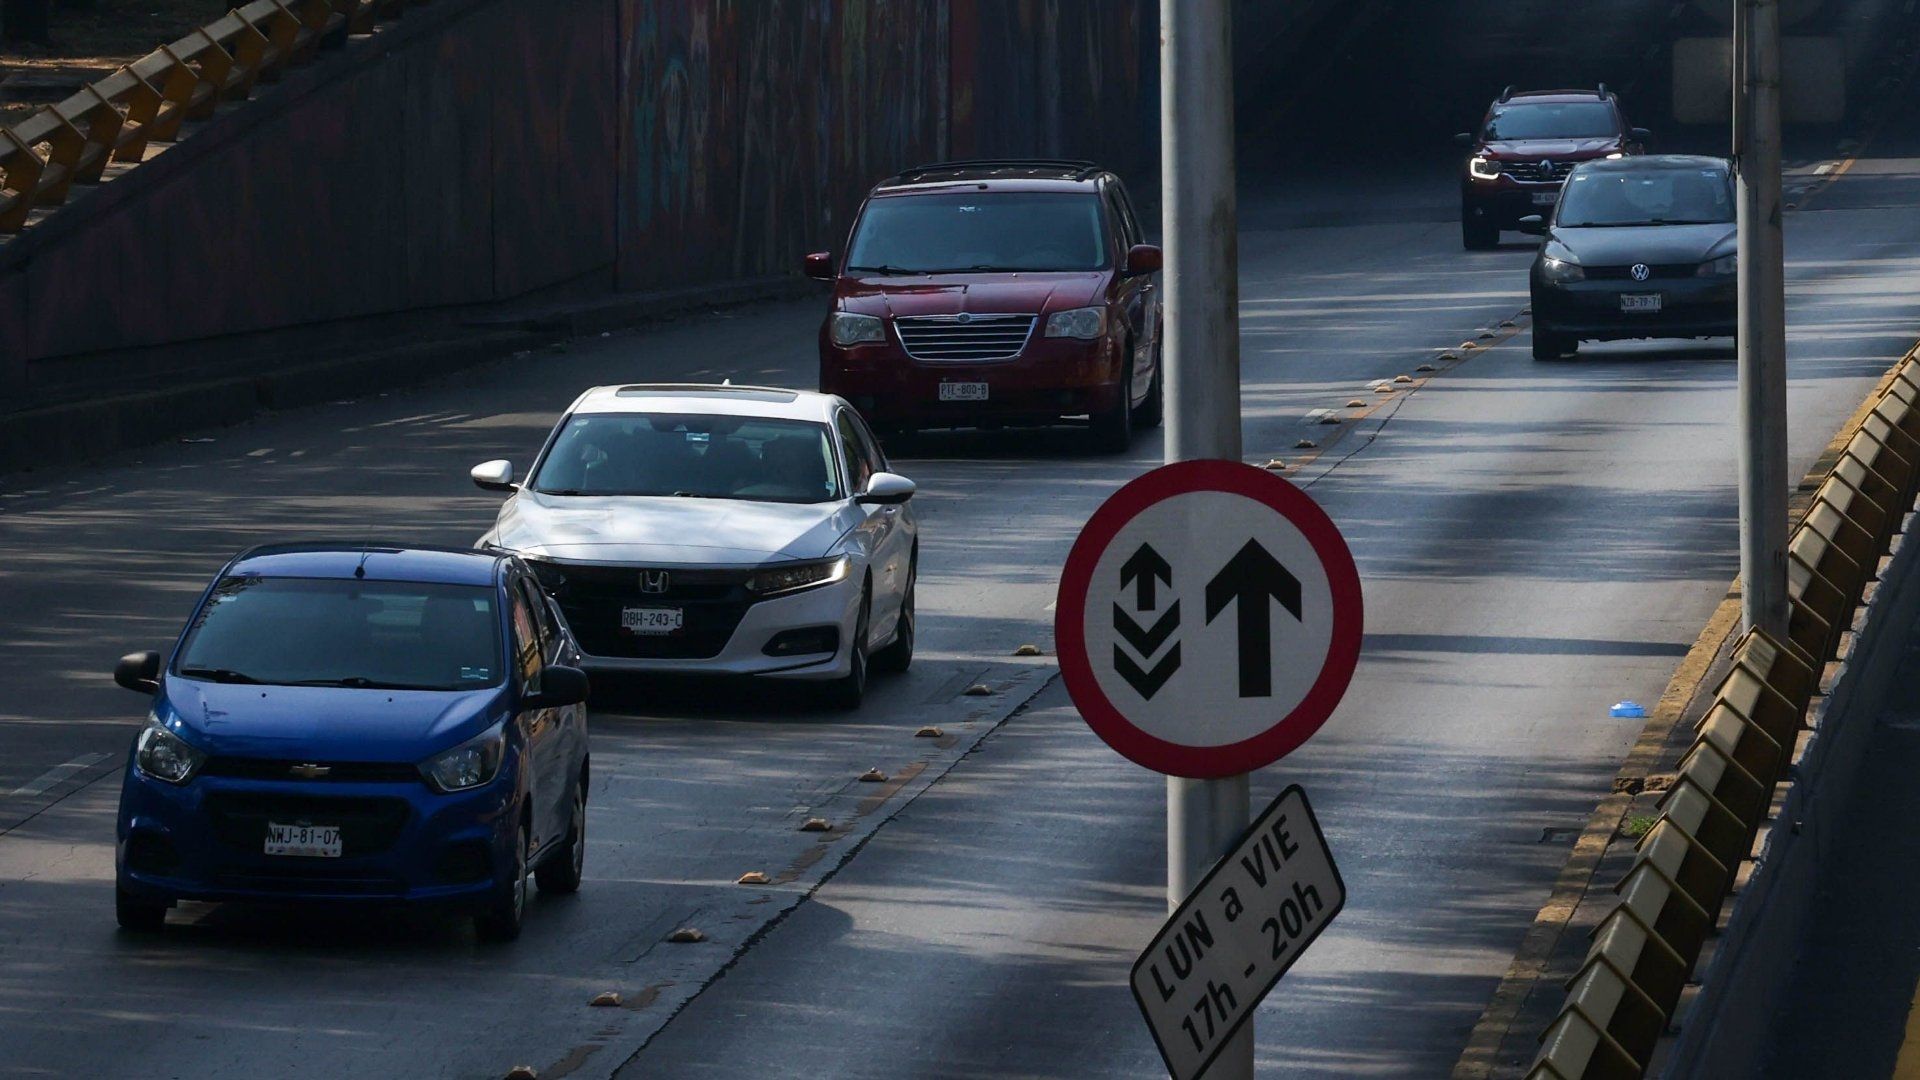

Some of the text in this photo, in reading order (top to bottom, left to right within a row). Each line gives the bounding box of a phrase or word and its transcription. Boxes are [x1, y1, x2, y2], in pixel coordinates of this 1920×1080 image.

[1631, 263, 1650, 281] VW
[623, 611, 682, 628] RBH-243-C
[1150, 814, 1299, 1002] LUN a VIE
[1182, 881, 1323, 1053] 17h - 20h
